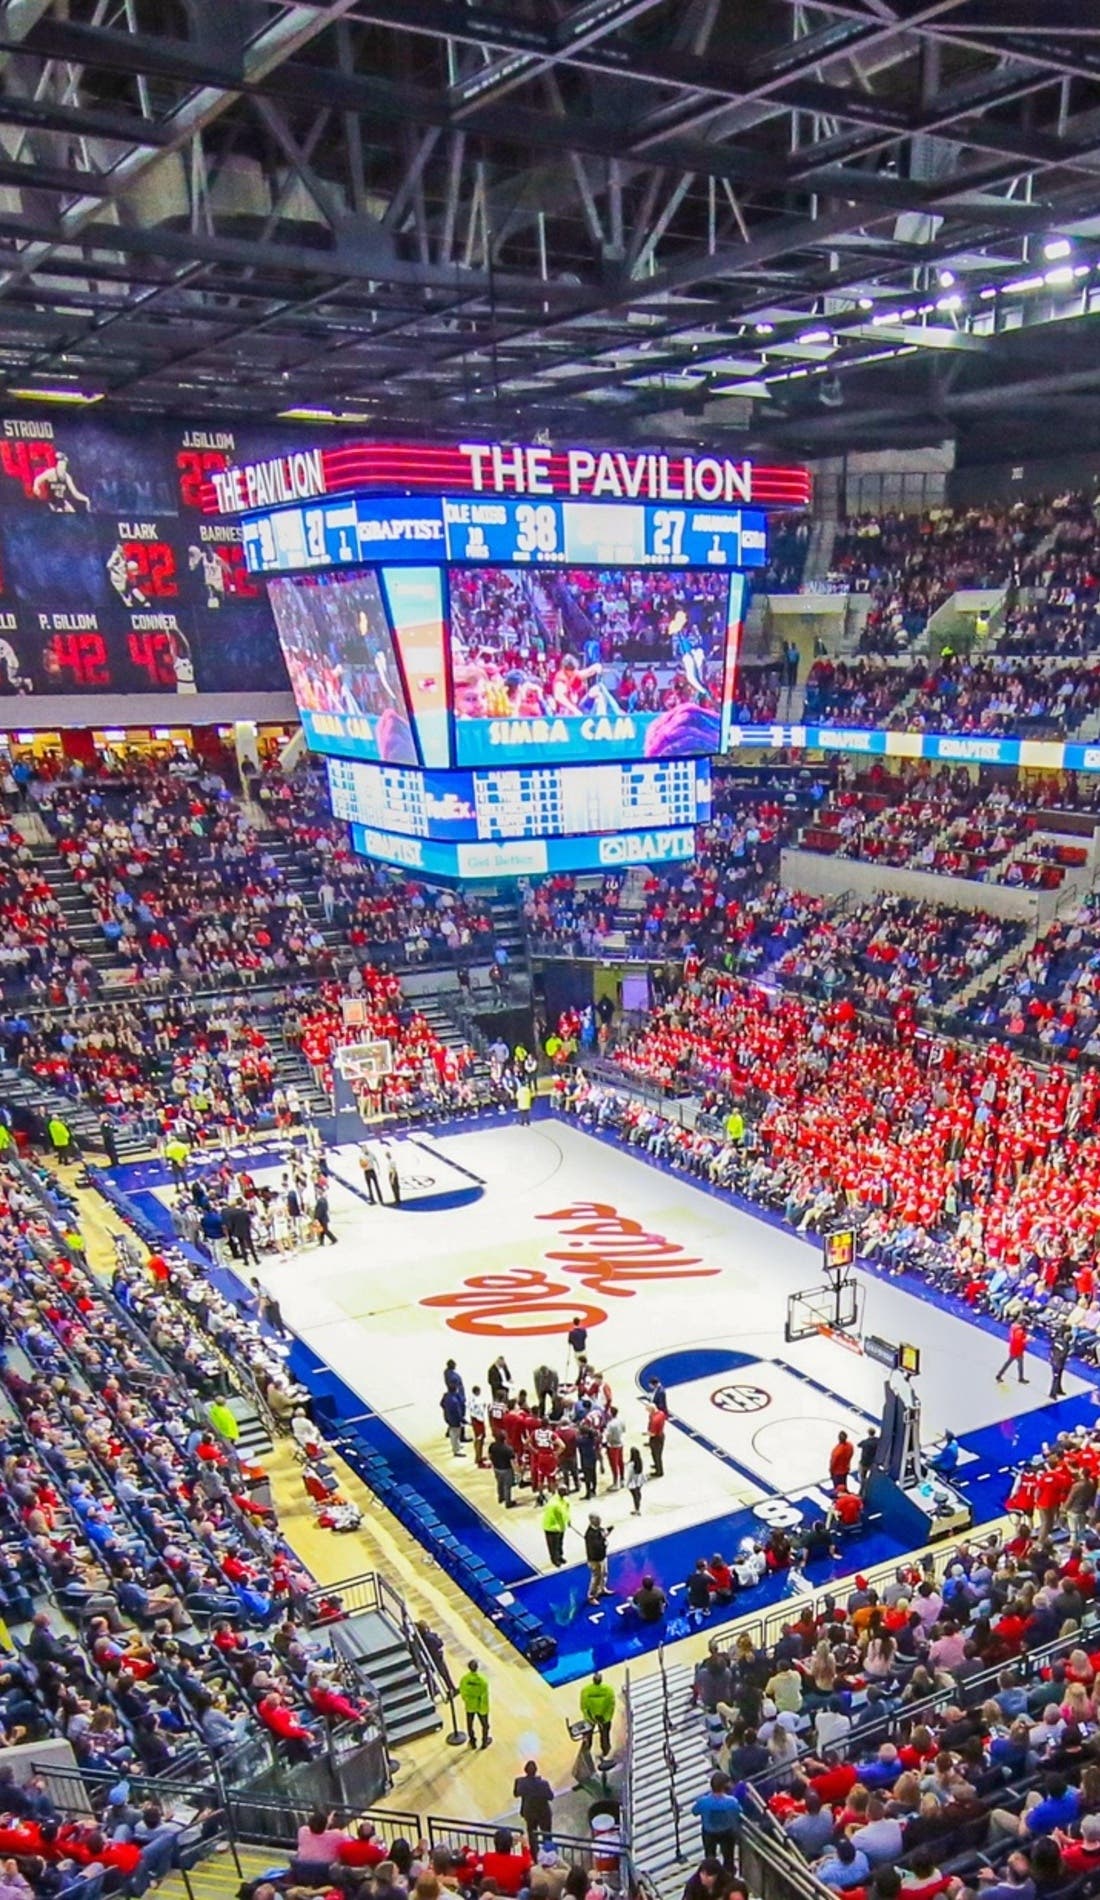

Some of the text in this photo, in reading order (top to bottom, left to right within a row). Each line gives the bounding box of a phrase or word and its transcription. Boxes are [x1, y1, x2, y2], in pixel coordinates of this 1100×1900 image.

[4, 420, 55, 439] STROUD
[211, 449, 326, 513] THE PAVILION
[459, 444, 752, 502] THE PAVILION
[118, 522, 159, 540] CLARK
[199, 525, 243, 542] BARNES
[371, 519, 442, 541] BAPTIST
[515, 504, 557, 552] 38
[653, 510, 686, 555] 27
[52, 614, 98, 630] GILLOM
[130, 614, 177, 630] CONNER
[489, 717, 636, 745] SIMBA CAM
[419, 1201, 723, 1337] Ole Miss
